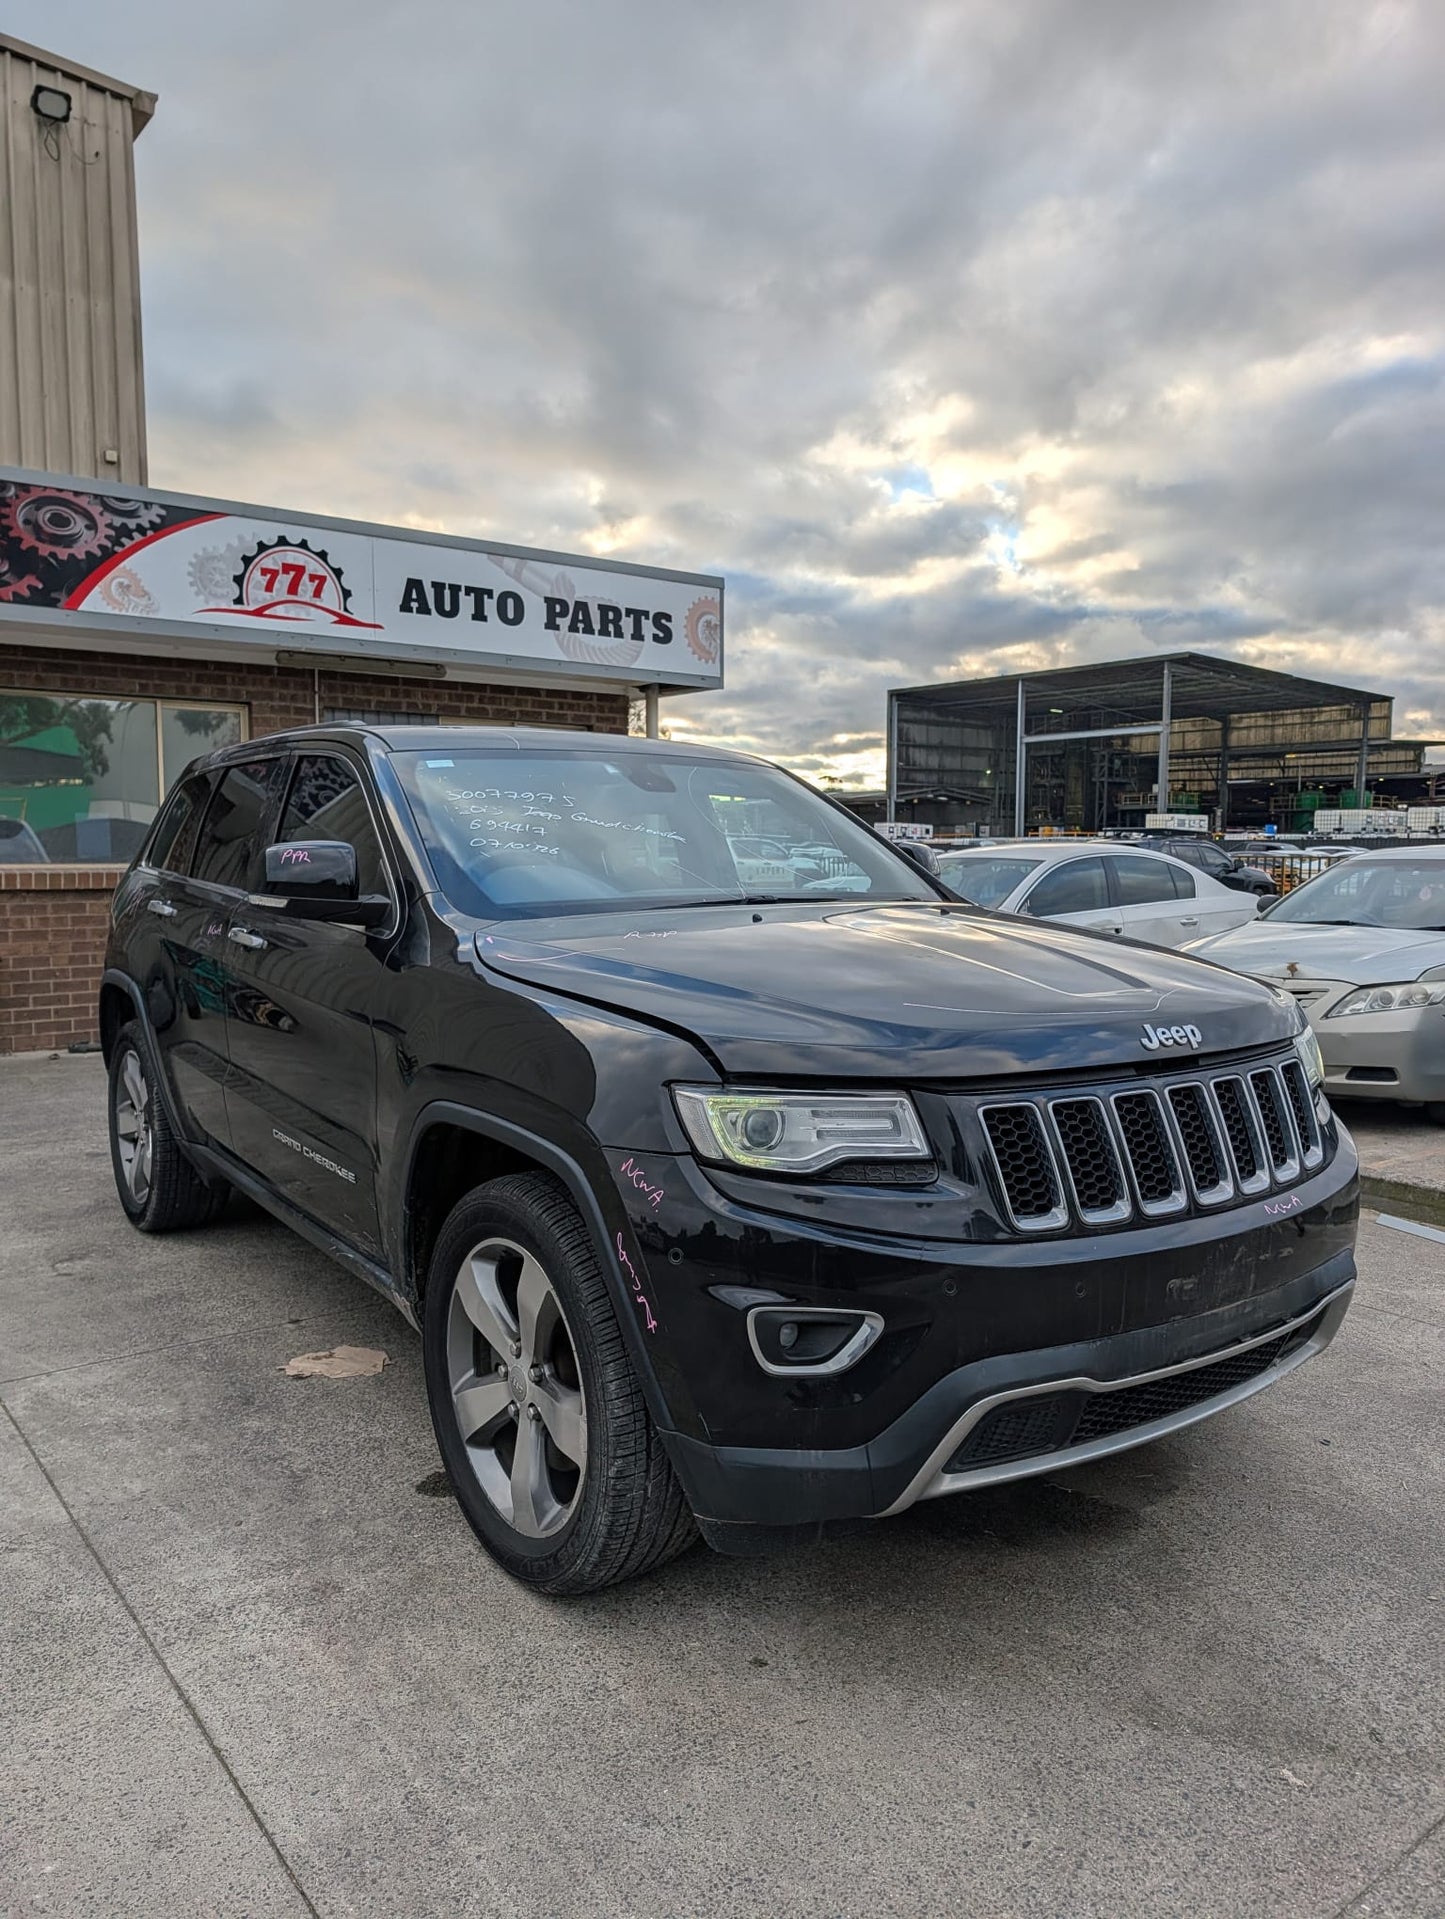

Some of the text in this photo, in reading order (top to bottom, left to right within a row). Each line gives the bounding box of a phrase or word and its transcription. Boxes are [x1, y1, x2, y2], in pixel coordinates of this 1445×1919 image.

[260, 562, 327, 599] 777
[399, 577, 673, 645] AUTO PARTS
[1140, 1023, 1202, 1051] Jeep
[272, 1128, 357, 1184] GRAND CHEROKEE
